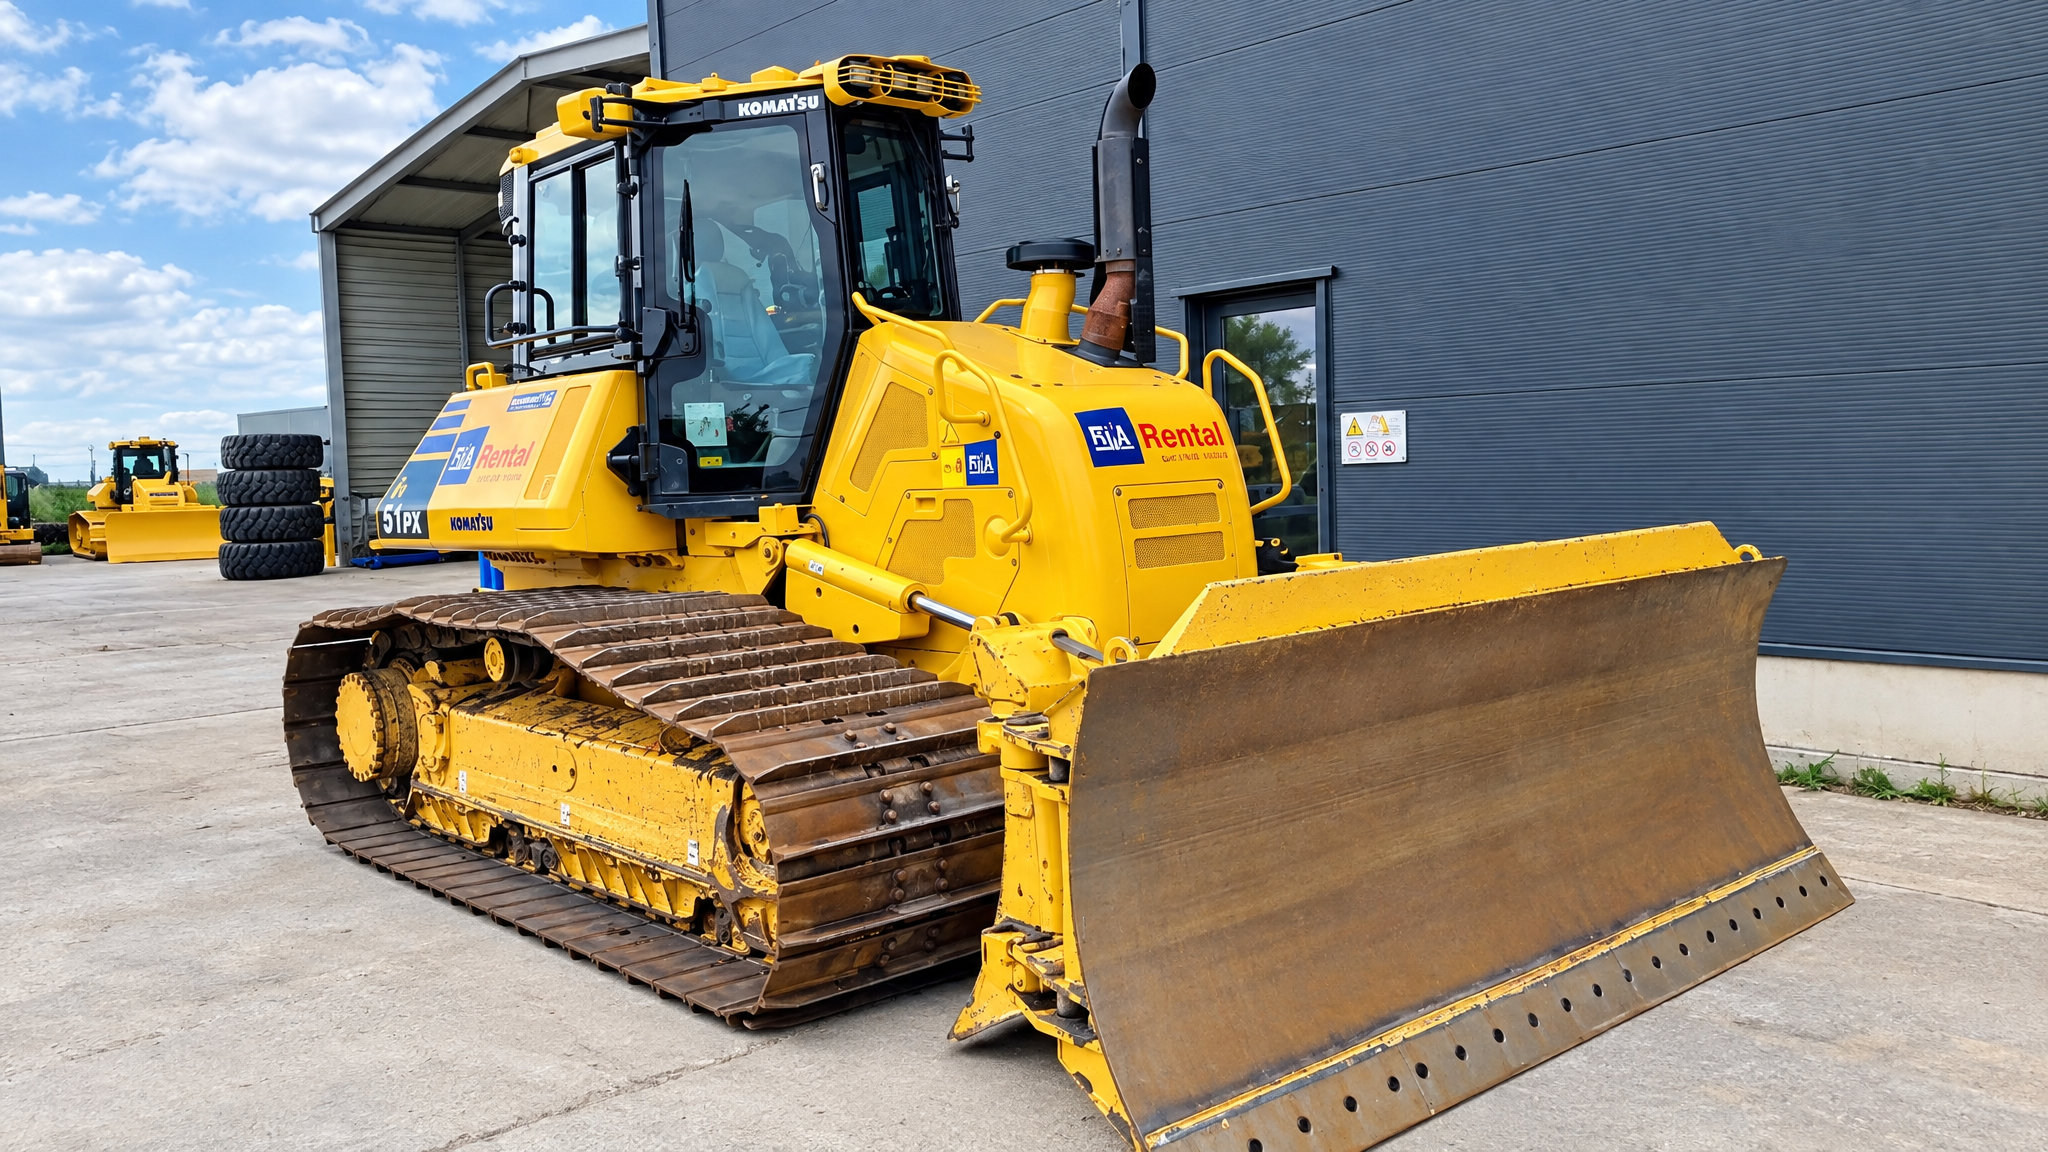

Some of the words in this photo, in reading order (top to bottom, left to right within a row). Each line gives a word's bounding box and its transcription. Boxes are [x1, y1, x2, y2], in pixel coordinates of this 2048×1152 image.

[738, 94, 819, 117] KOMATSU
[1138, 421, 1224, 449] Rental
[476, 441, 535, 469] Rental
[383, 503, 422, 534] 51PX
[450, 513, 493, 531] KOMATSU
